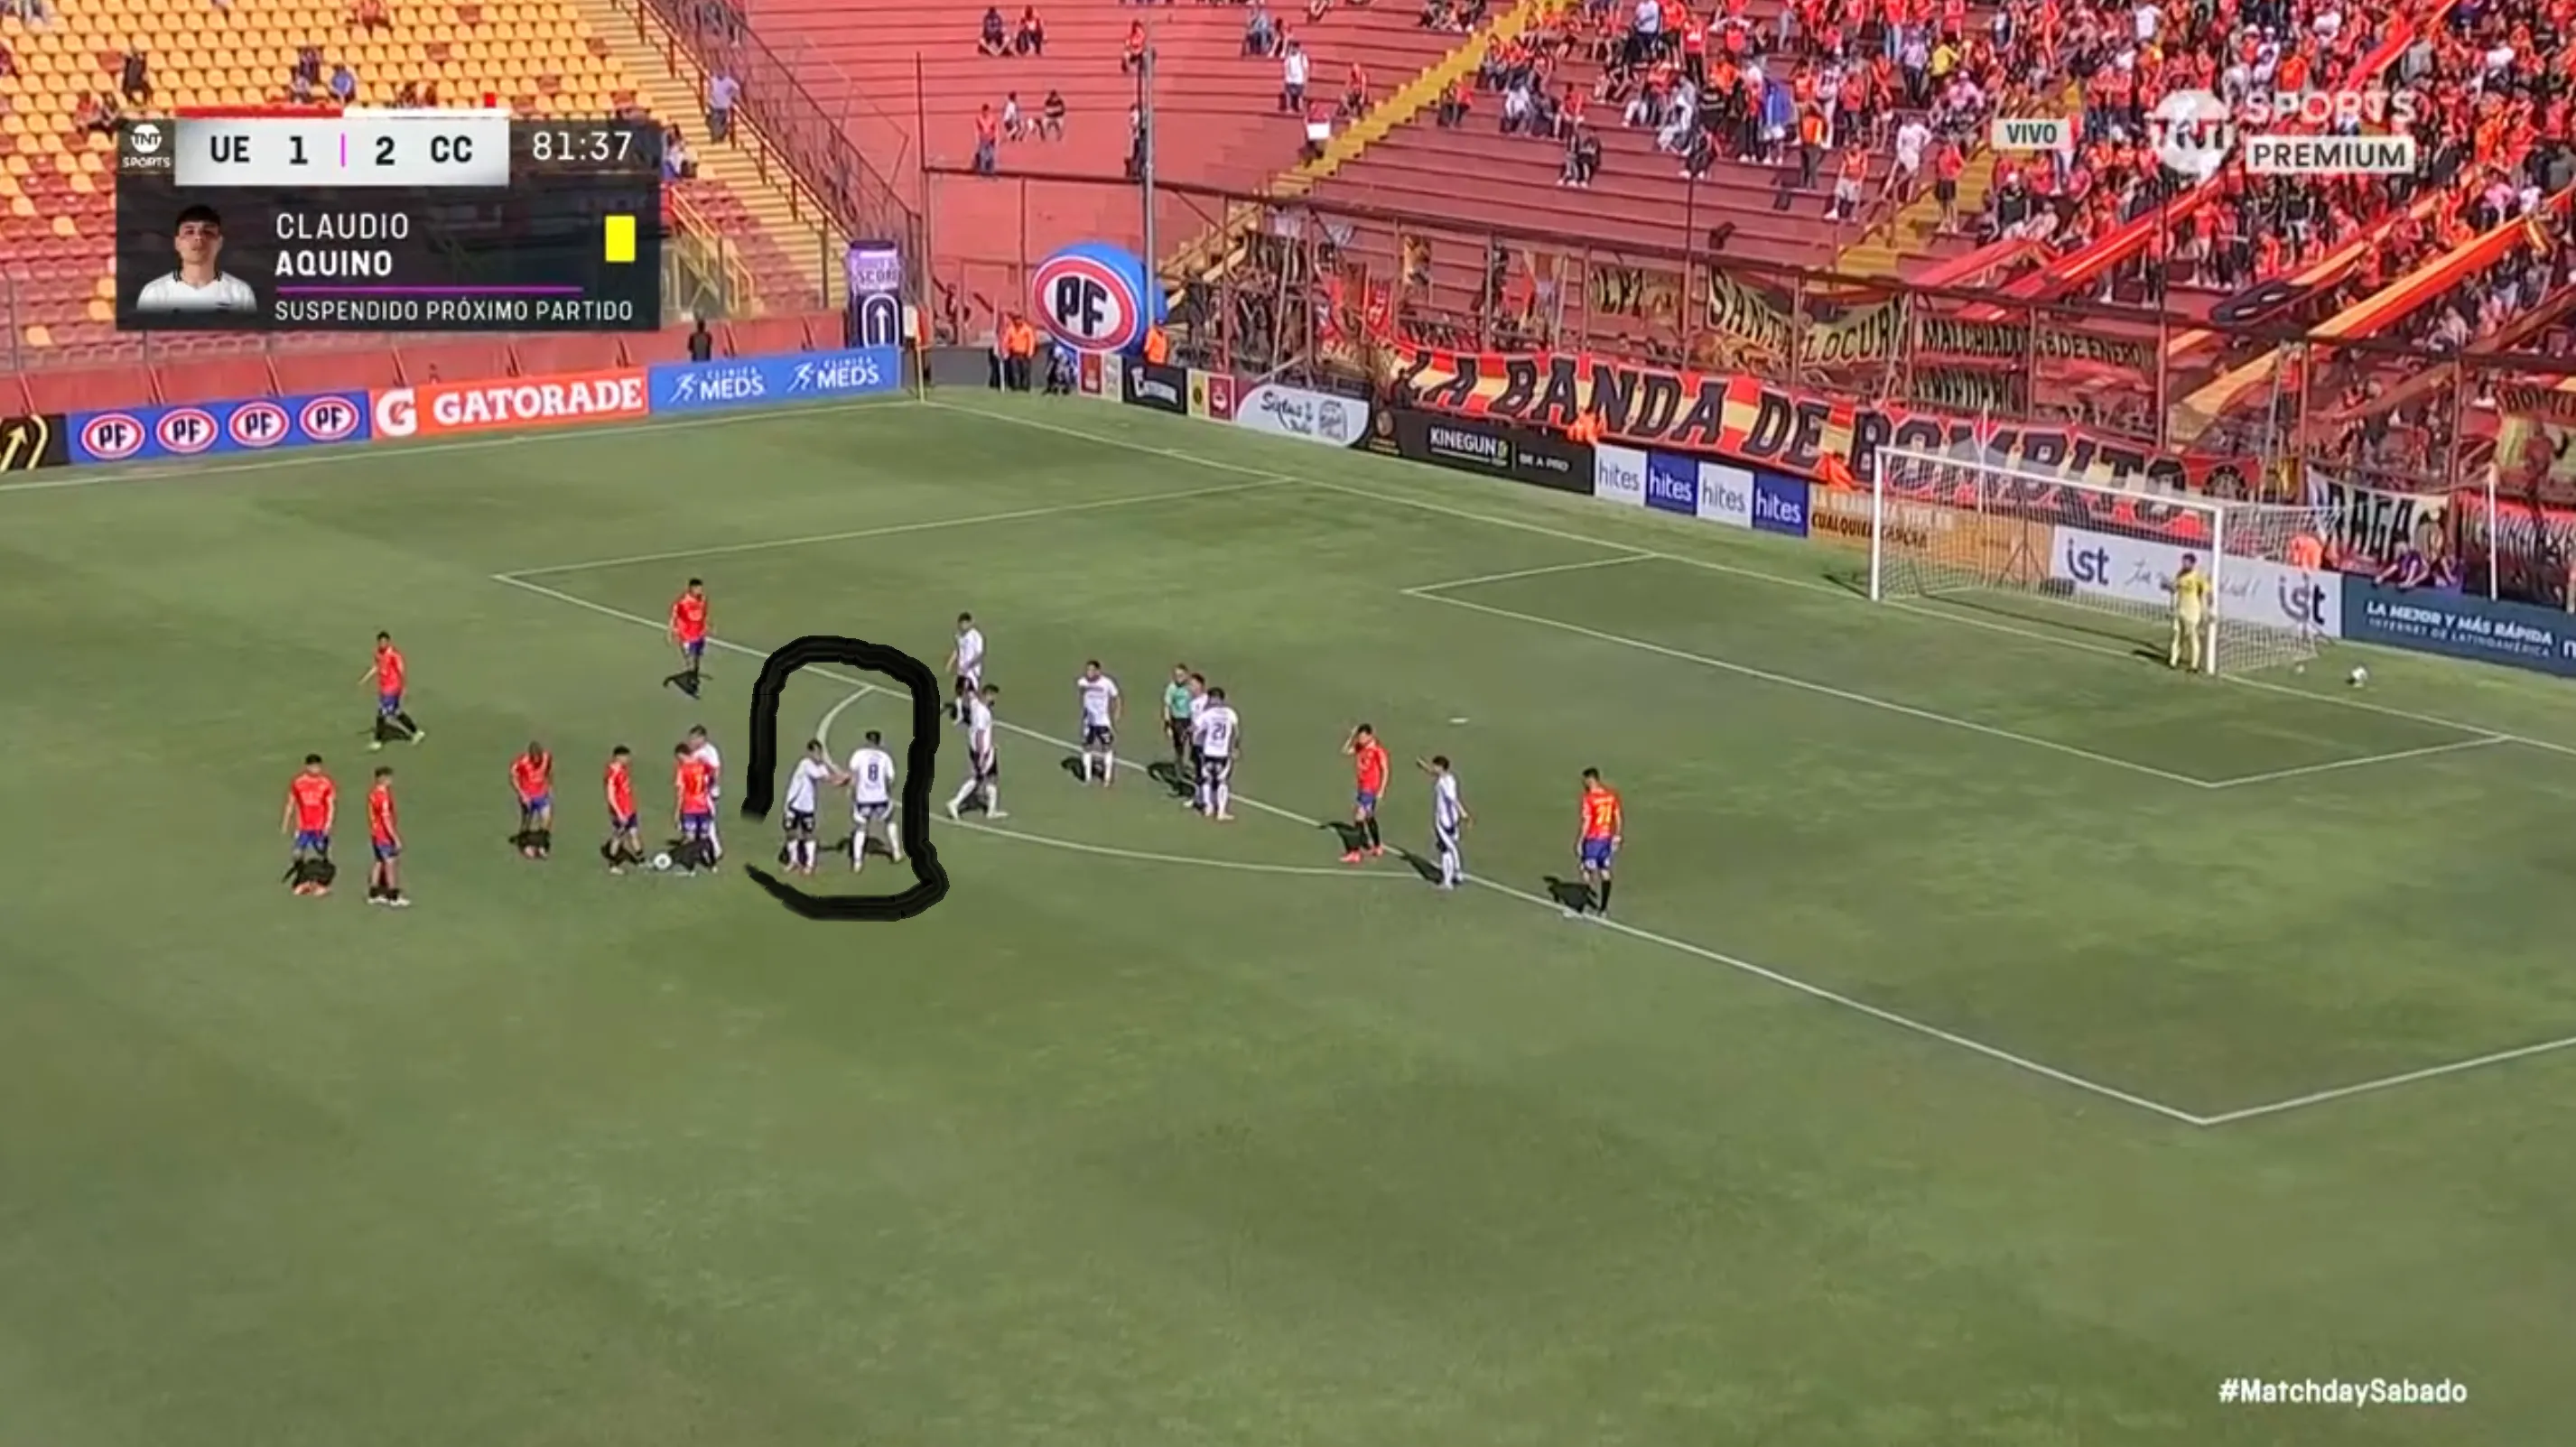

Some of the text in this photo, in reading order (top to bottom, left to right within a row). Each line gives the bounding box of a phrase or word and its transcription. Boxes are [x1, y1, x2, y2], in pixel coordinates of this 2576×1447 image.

[1056, 275, 1109, 337] PF
[700, 376, 765, 401] MEDS
[816, 364, 879, 389] MEDS
[316, 406, 343, 431] PF
[376, 378, 642, 437] G GATORADE
[1405, 350, 1478, 406] LA
[1492, 356, 1729, 446] BANDA
[1742, 391, 1827, 464] DE
[98, 423, 127, 449] PF
[172, 418, 201, 444] PF
[246, 413, 274, 438] PF
[1430, 427, 1497, 456] KINEGUN
[1598, 459, 1640, 491] hites
[1650, 468, 1692, 502] hites
[1702, 478, 1746, 512] hites
[1755, 487, 1801, 524] hites
[2068, 538, 2109, 586] ist
[2279, 577, 2326, 625] ist
[2367, 601, 2553, 645] LA MEJOR Y MÁS RÁPIDA
[868, 764, 878, 782] 8
